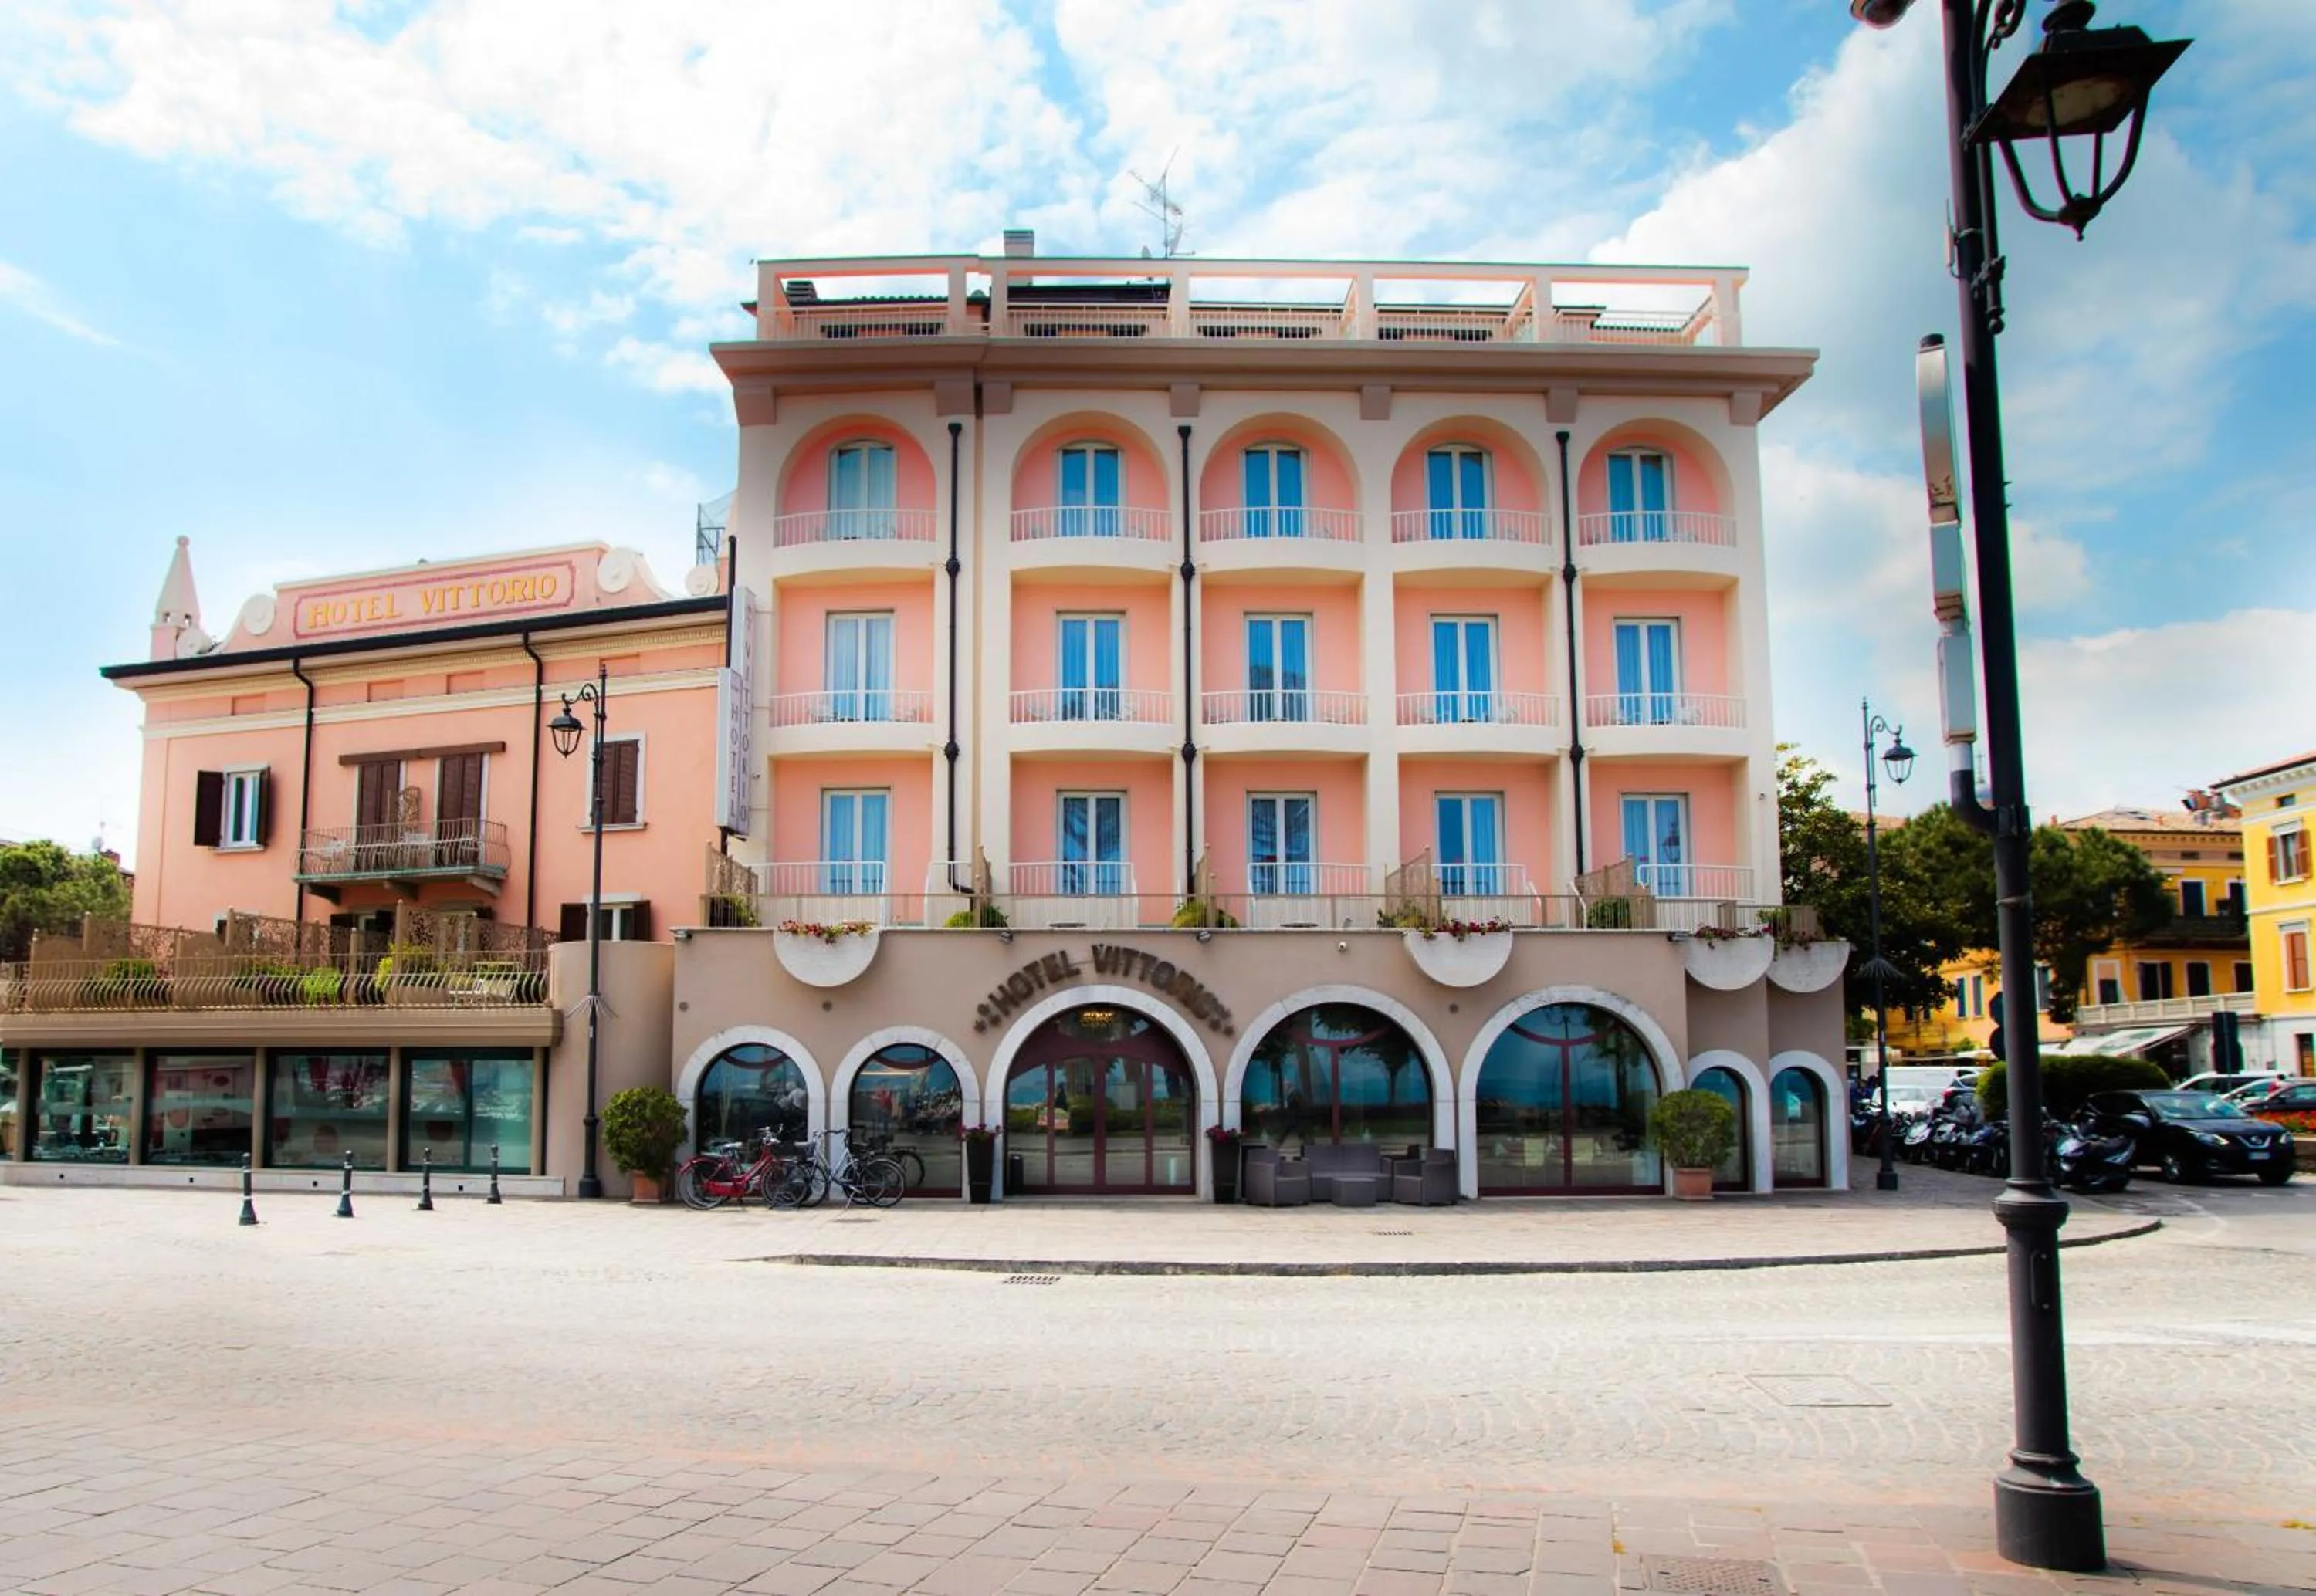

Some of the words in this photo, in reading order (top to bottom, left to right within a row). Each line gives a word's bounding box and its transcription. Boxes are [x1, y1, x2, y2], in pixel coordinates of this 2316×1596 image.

[308, 593, 403, 630] HOTEL
[419, 574, 557, 615] VITTORIO
[730, 703, 739, 818] HOTEL
[988, 950, 1081, 1017] HOTEL
[1091, 944, 1220, 1019] VITTORIO
